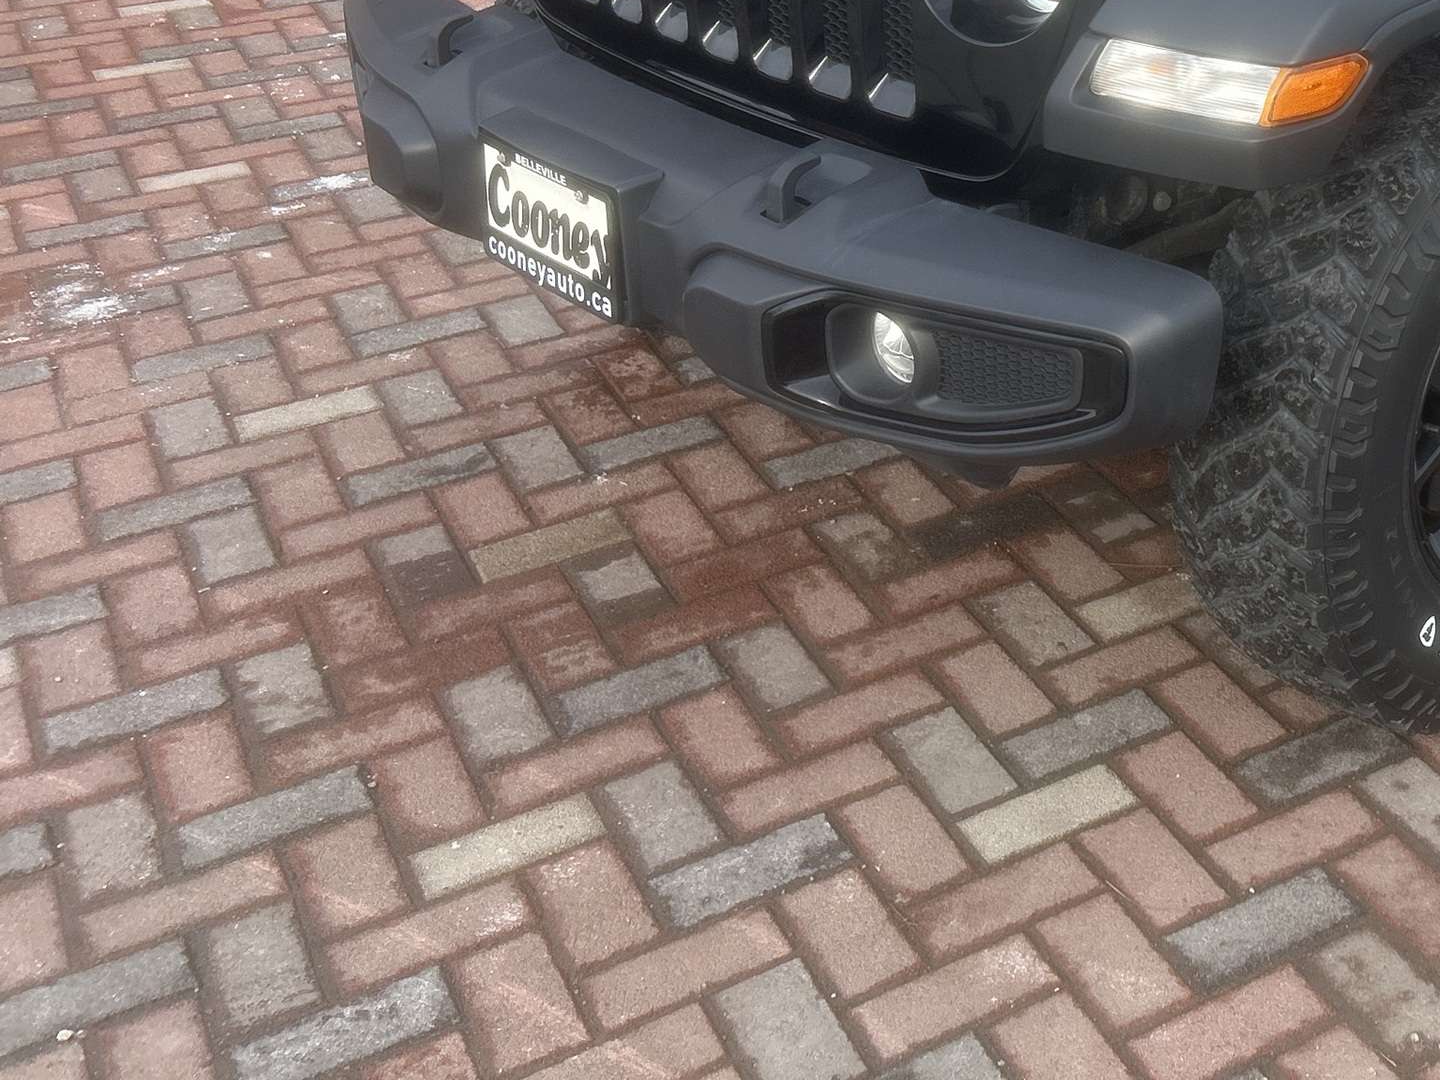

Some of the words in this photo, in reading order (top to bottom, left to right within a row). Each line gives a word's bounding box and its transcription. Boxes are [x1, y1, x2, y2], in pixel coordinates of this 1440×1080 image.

[514, 152, 568, 187] BELLEVILLE
[488, 163, 611, 288] Cooney
[488, 235, 612, 318] cooneyauto.ca
